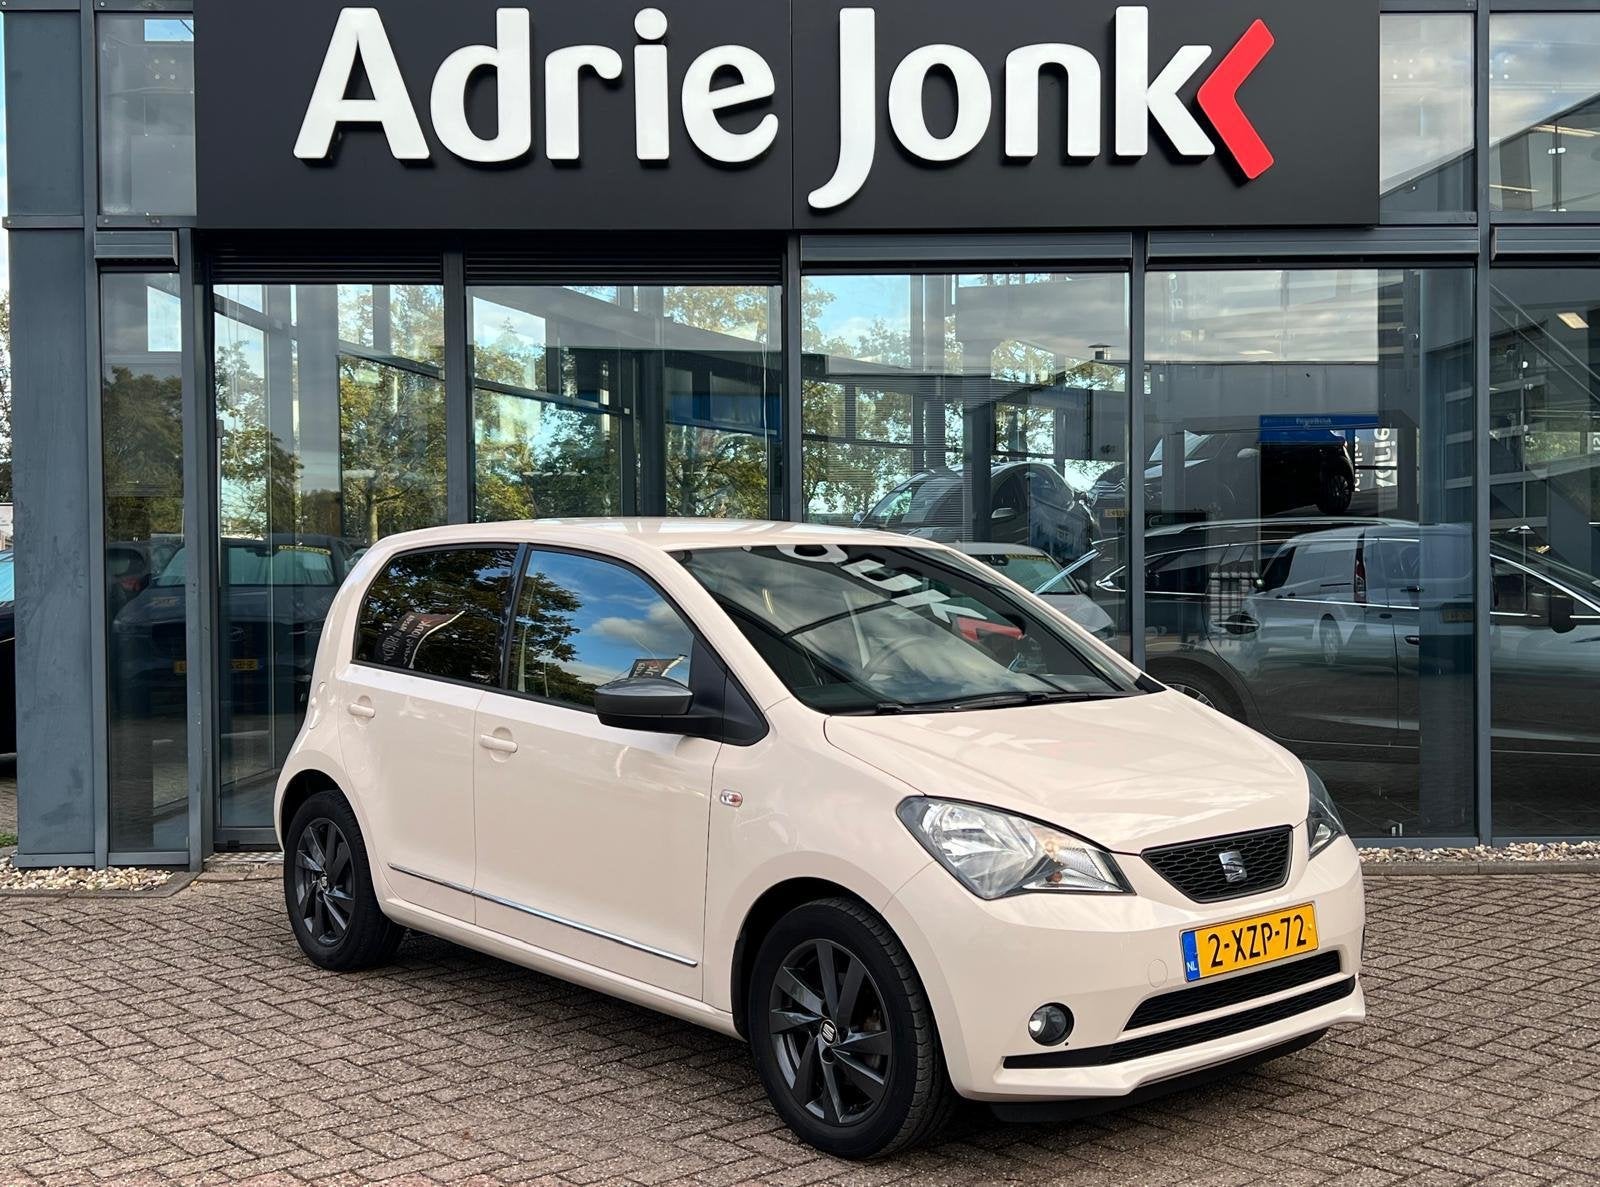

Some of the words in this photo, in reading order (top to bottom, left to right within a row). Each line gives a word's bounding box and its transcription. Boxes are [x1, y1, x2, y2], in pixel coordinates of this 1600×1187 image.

[293, 7, 779, 162] Adrie
[807, 5, 1216, 209] Jonk
[1187, 961, 1198, 972] NL
[1207, 914, 1307, 968] 2-XZP-72
